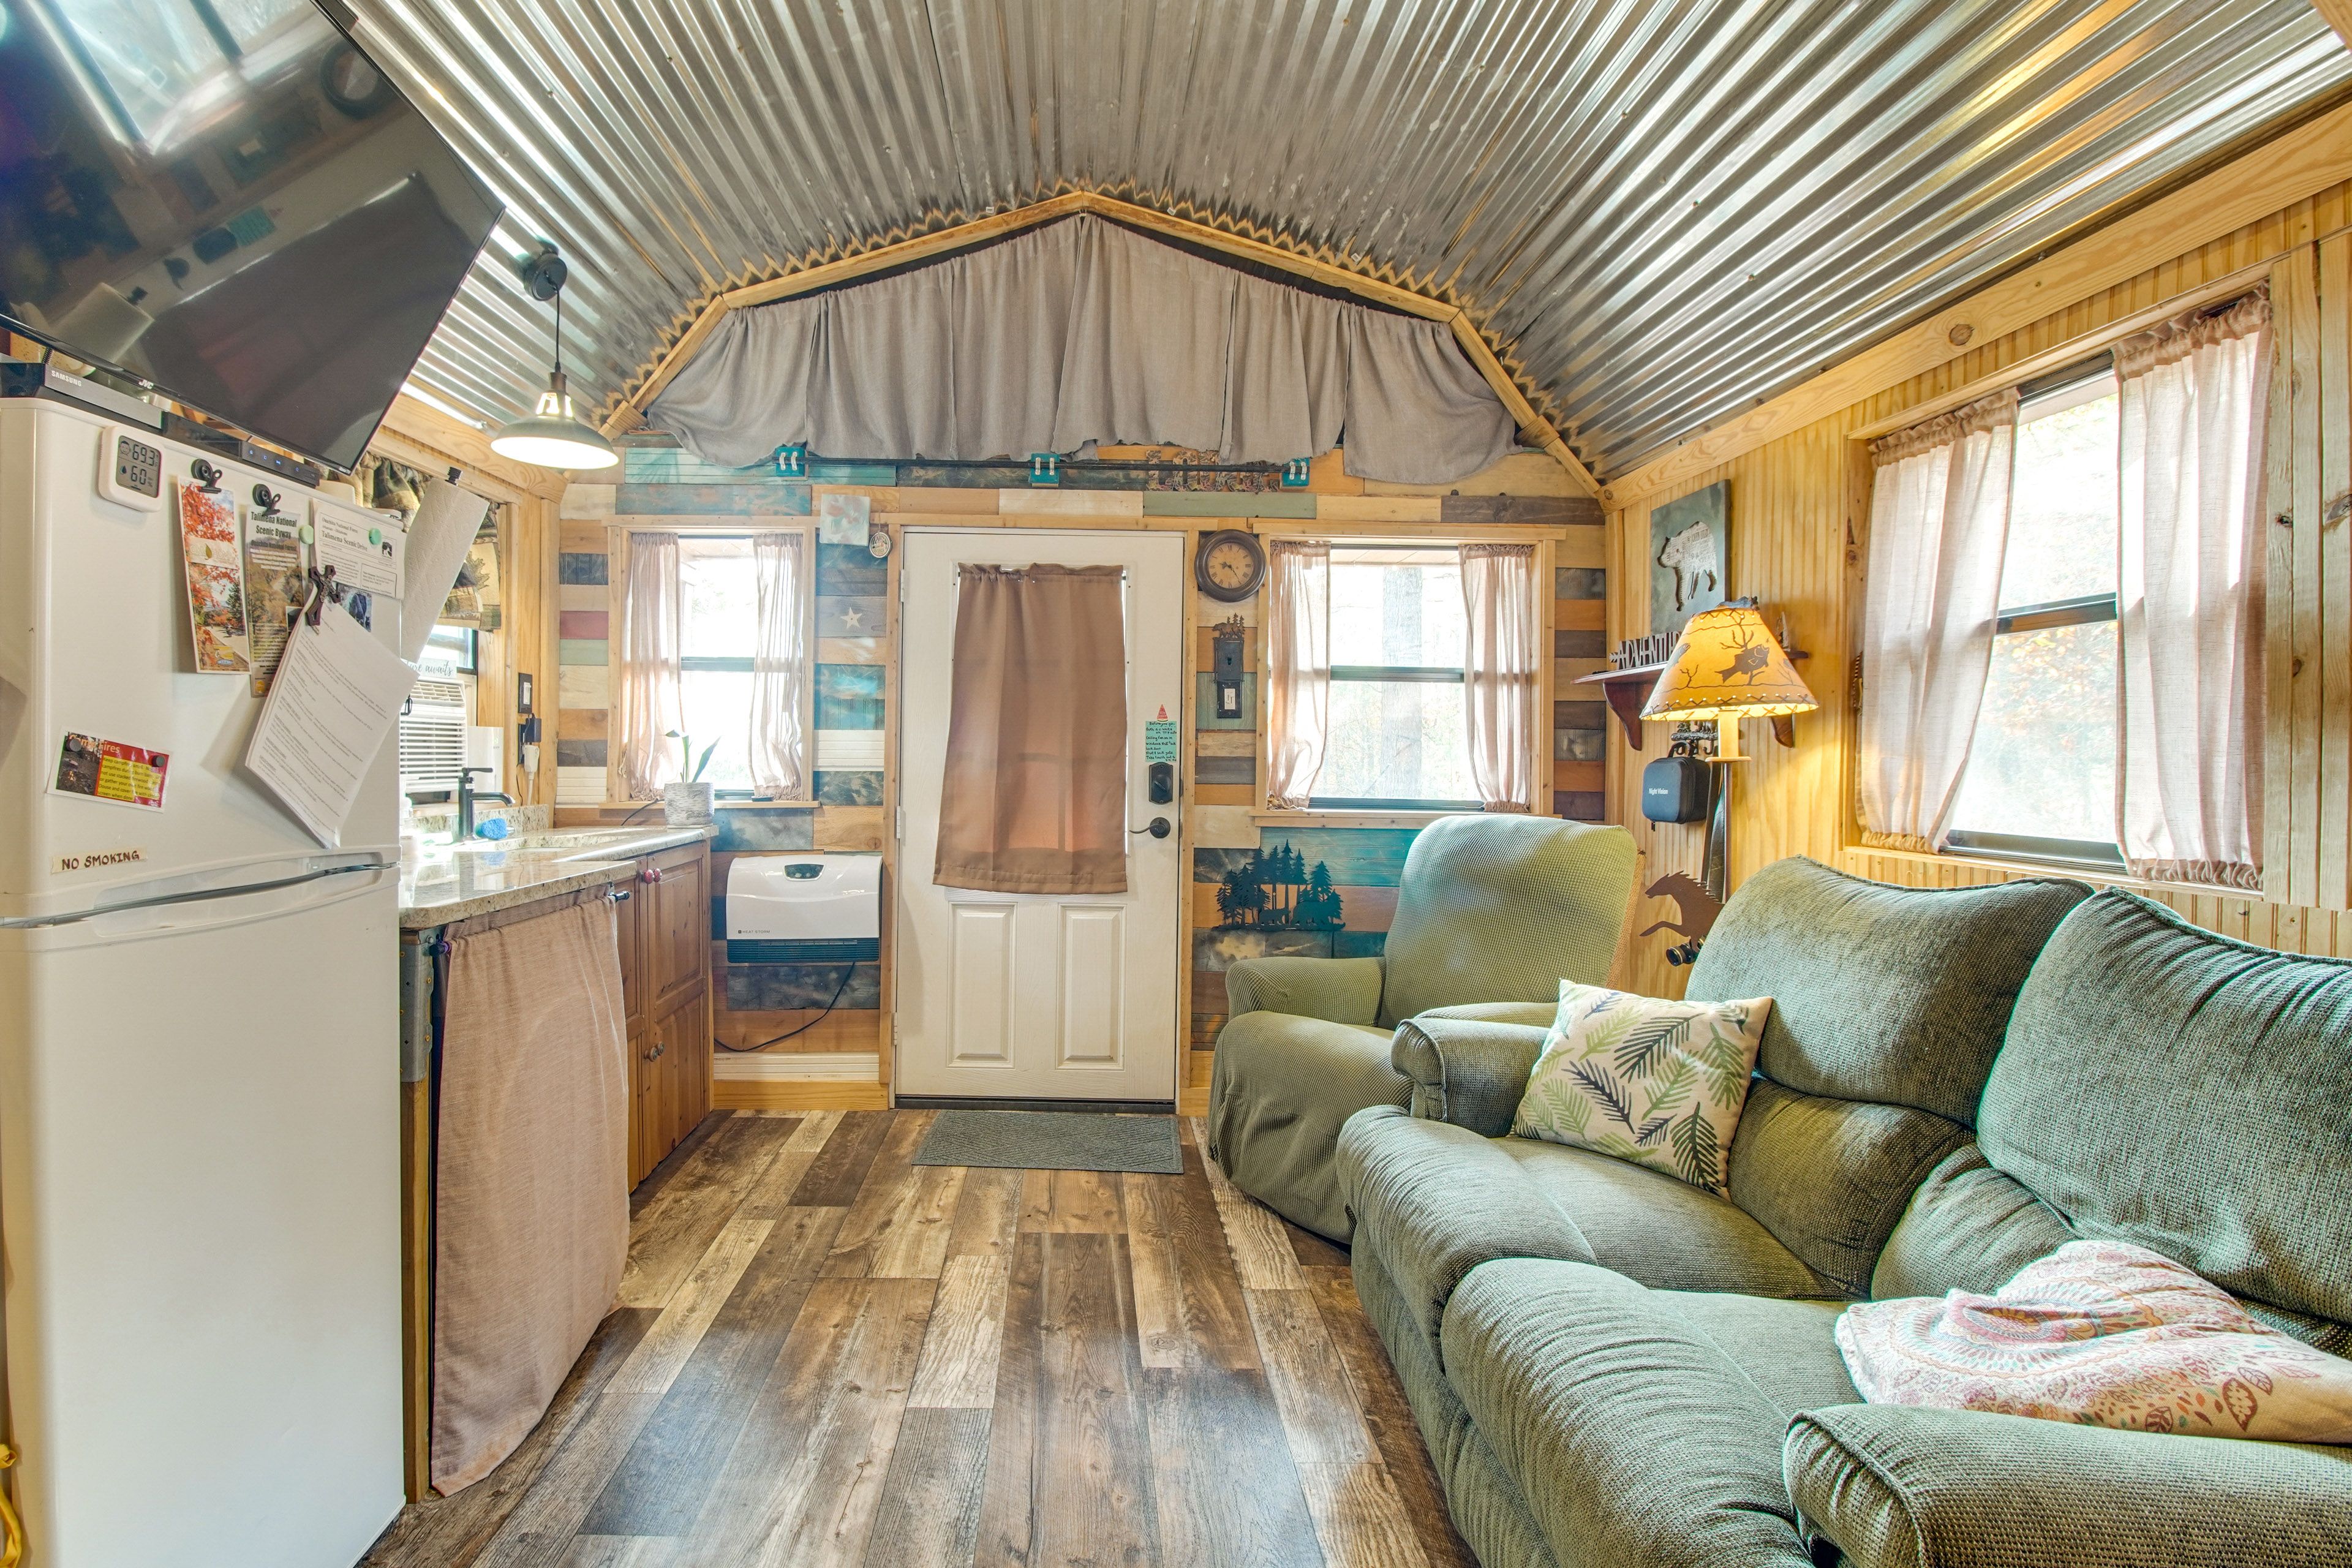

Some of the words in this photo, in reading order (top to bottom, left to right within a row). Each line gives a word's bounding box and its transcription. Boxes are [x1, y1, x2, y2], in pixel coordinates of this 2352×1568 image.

[51, 370, 82, 387] SAMSUNG
[138, 379, 154, 390] JVC
[131, 466, 146, 484] 60
[251, 511, 275, 524] Talimena
[276, 516, 297, 527] National
[256, 525, 274, 536] Scenic
[275, 528, 292, 539] Byway
[321, 530, 342, 543] Talimena
[344, 537, 357, 548] Scenic
[357, 542, 368, 551] Drive
[425, 661, 453, 677] awaits
[69, 734, 97, 749] Cmp
[99, 741, 121, 754] Fires
[62, 858, 79, 870] NO
[84, 850, 140, 869] SMOKING
